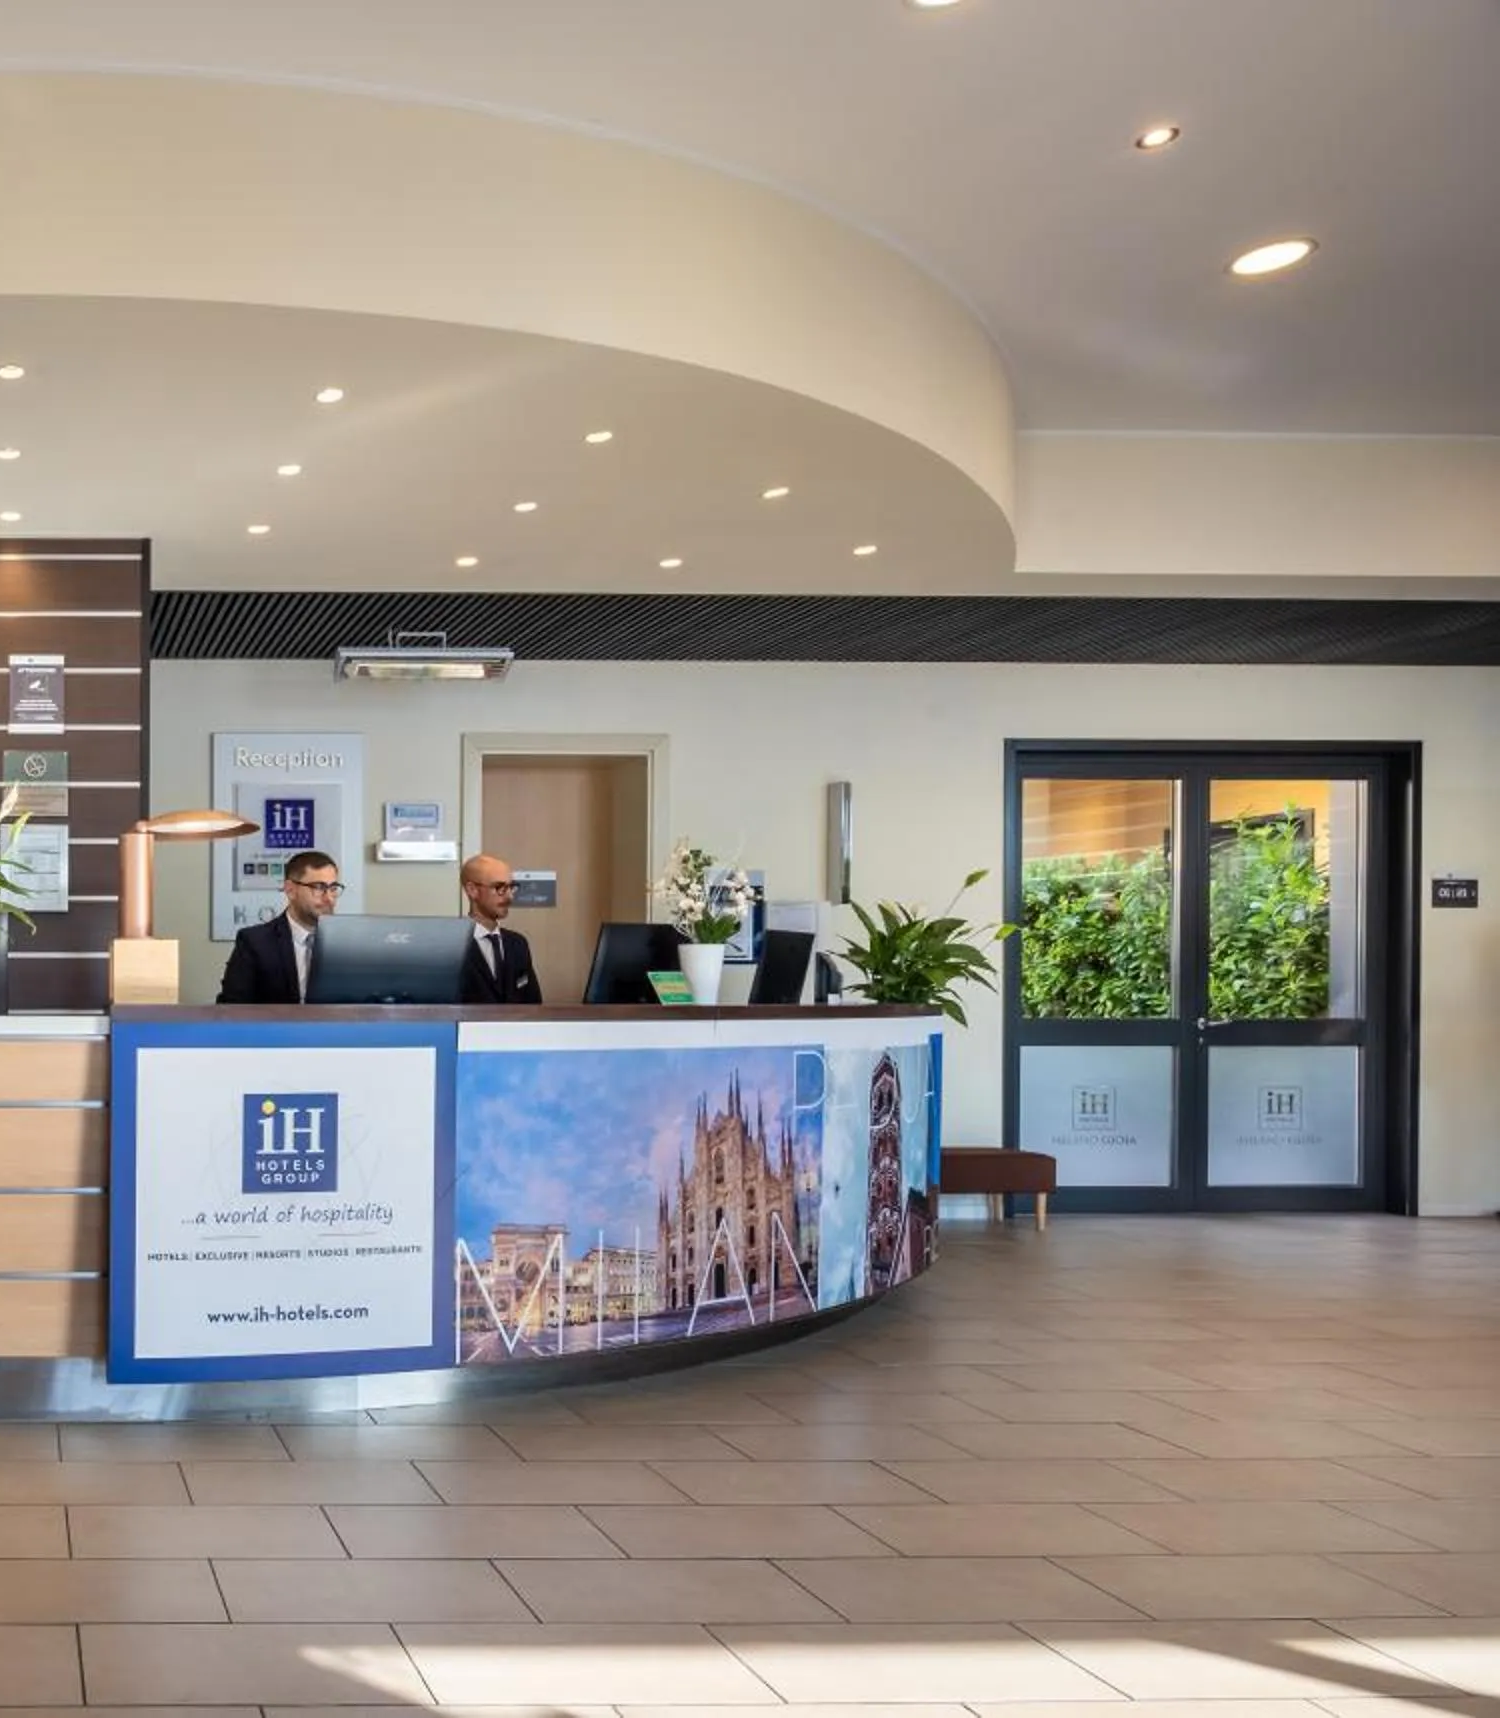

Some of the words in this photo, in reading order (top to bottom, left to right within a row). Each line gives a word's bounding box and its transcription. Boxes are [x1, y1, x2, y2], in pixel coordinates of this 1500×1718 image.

[234, 747, 343, 773] Reception
[271, 804, 309, 831] iH
[255, 1099, 326, 1155] iH
[255, 1159, 326, 1171] HOTELS
[261, 1171, 321, 1184] GROUP
[214, 1205, 269, 1224] world
[275, 1204, 295, 1224] of
[300, 1203, 394, 1226] hospitality
[207, 1303, 369, 1323] www.ih-hotels.com
